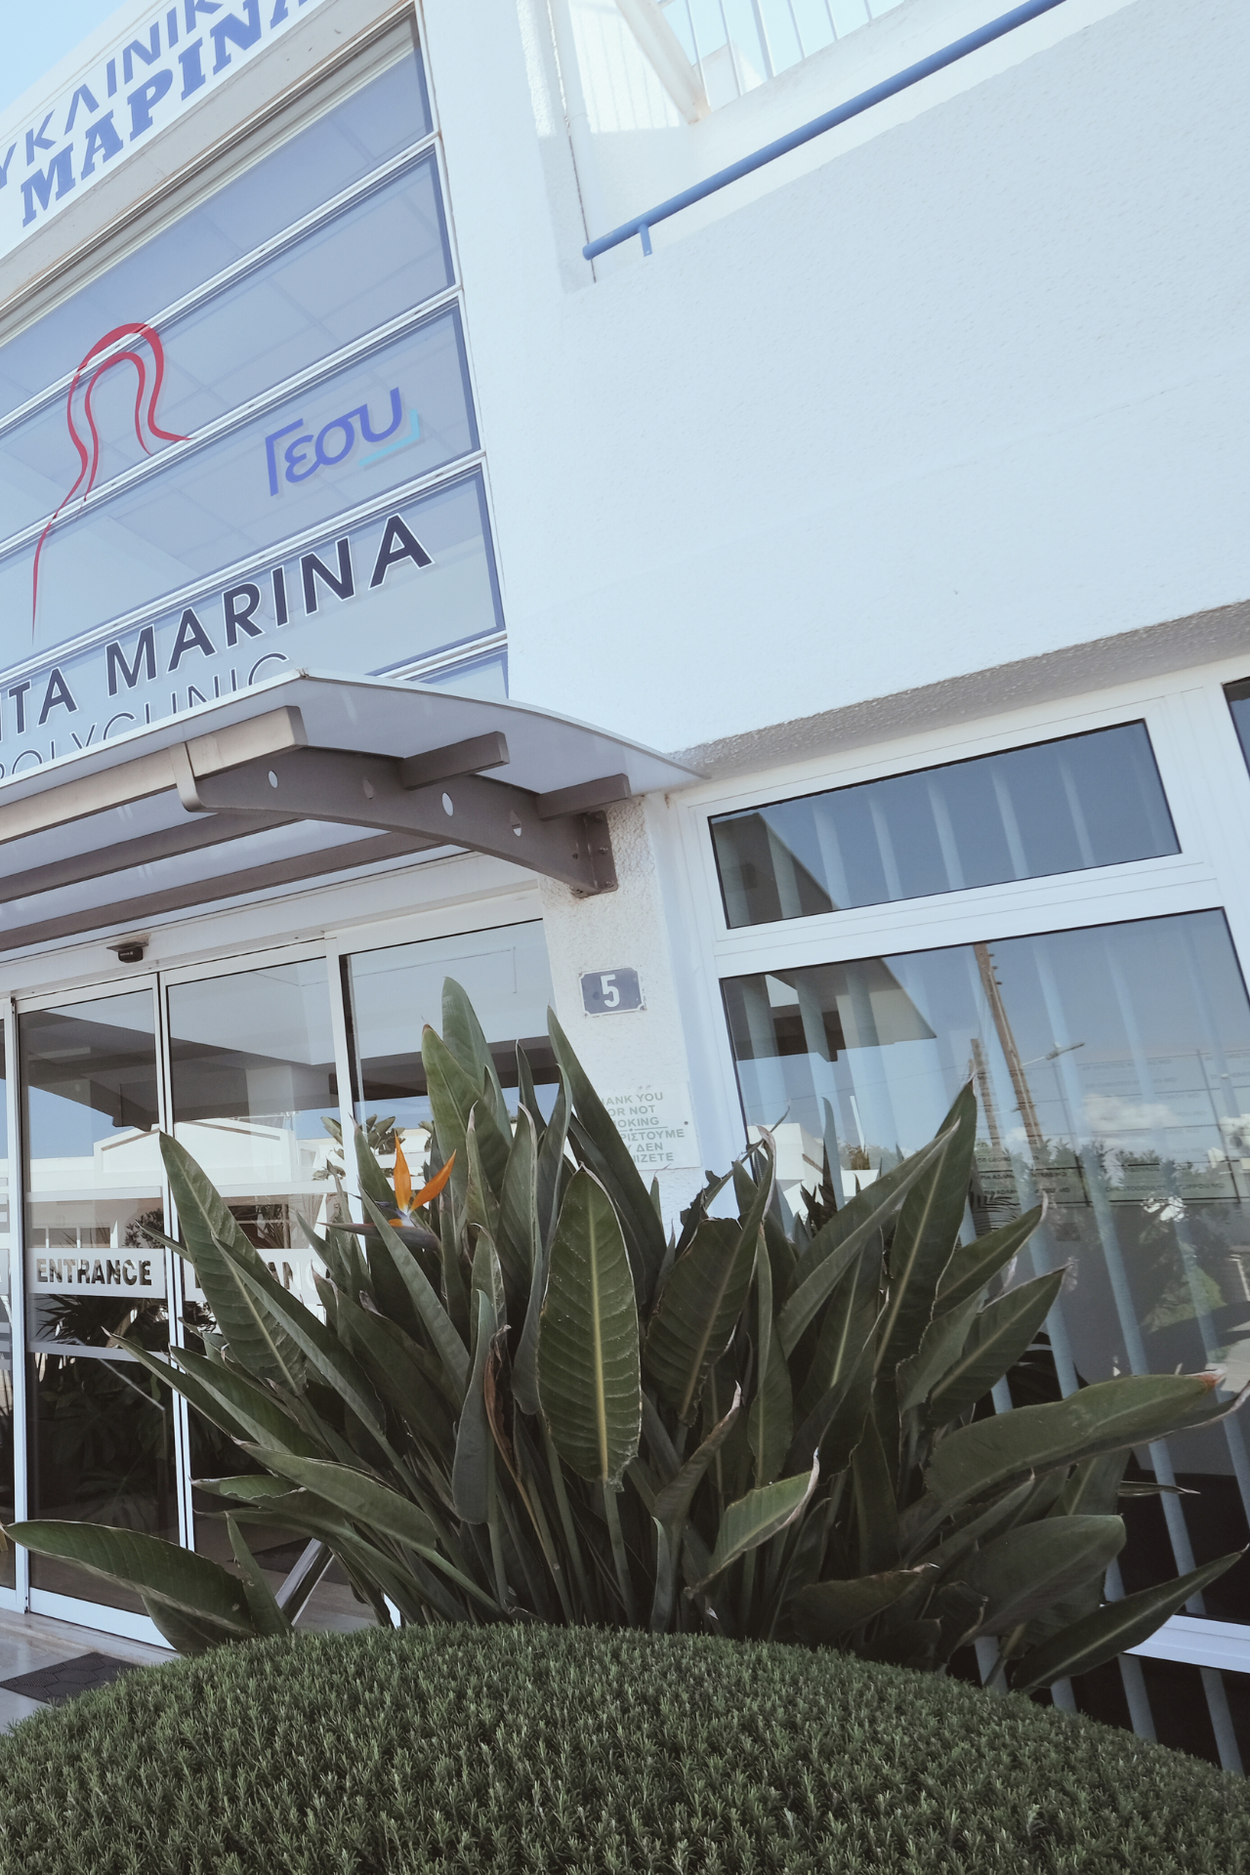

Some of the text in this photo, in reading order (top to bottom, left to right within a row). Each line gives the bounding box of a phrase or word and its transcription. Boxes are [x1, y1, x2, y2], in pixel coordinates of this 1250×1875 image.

[105, 513, 435, 697] MARINA
[600, 973, 621, 1008] 5
[601, 1092, 663, 1105] ANK YOU
[607, 1105, 655, 1116] OR NOT
[614, 1117, 659, 1128] OKING
[621, 1129, 685, 1141] ΡΙΣΤΟΥΜΕ
[37, 1258, 152, 1287] ENTRANCE
